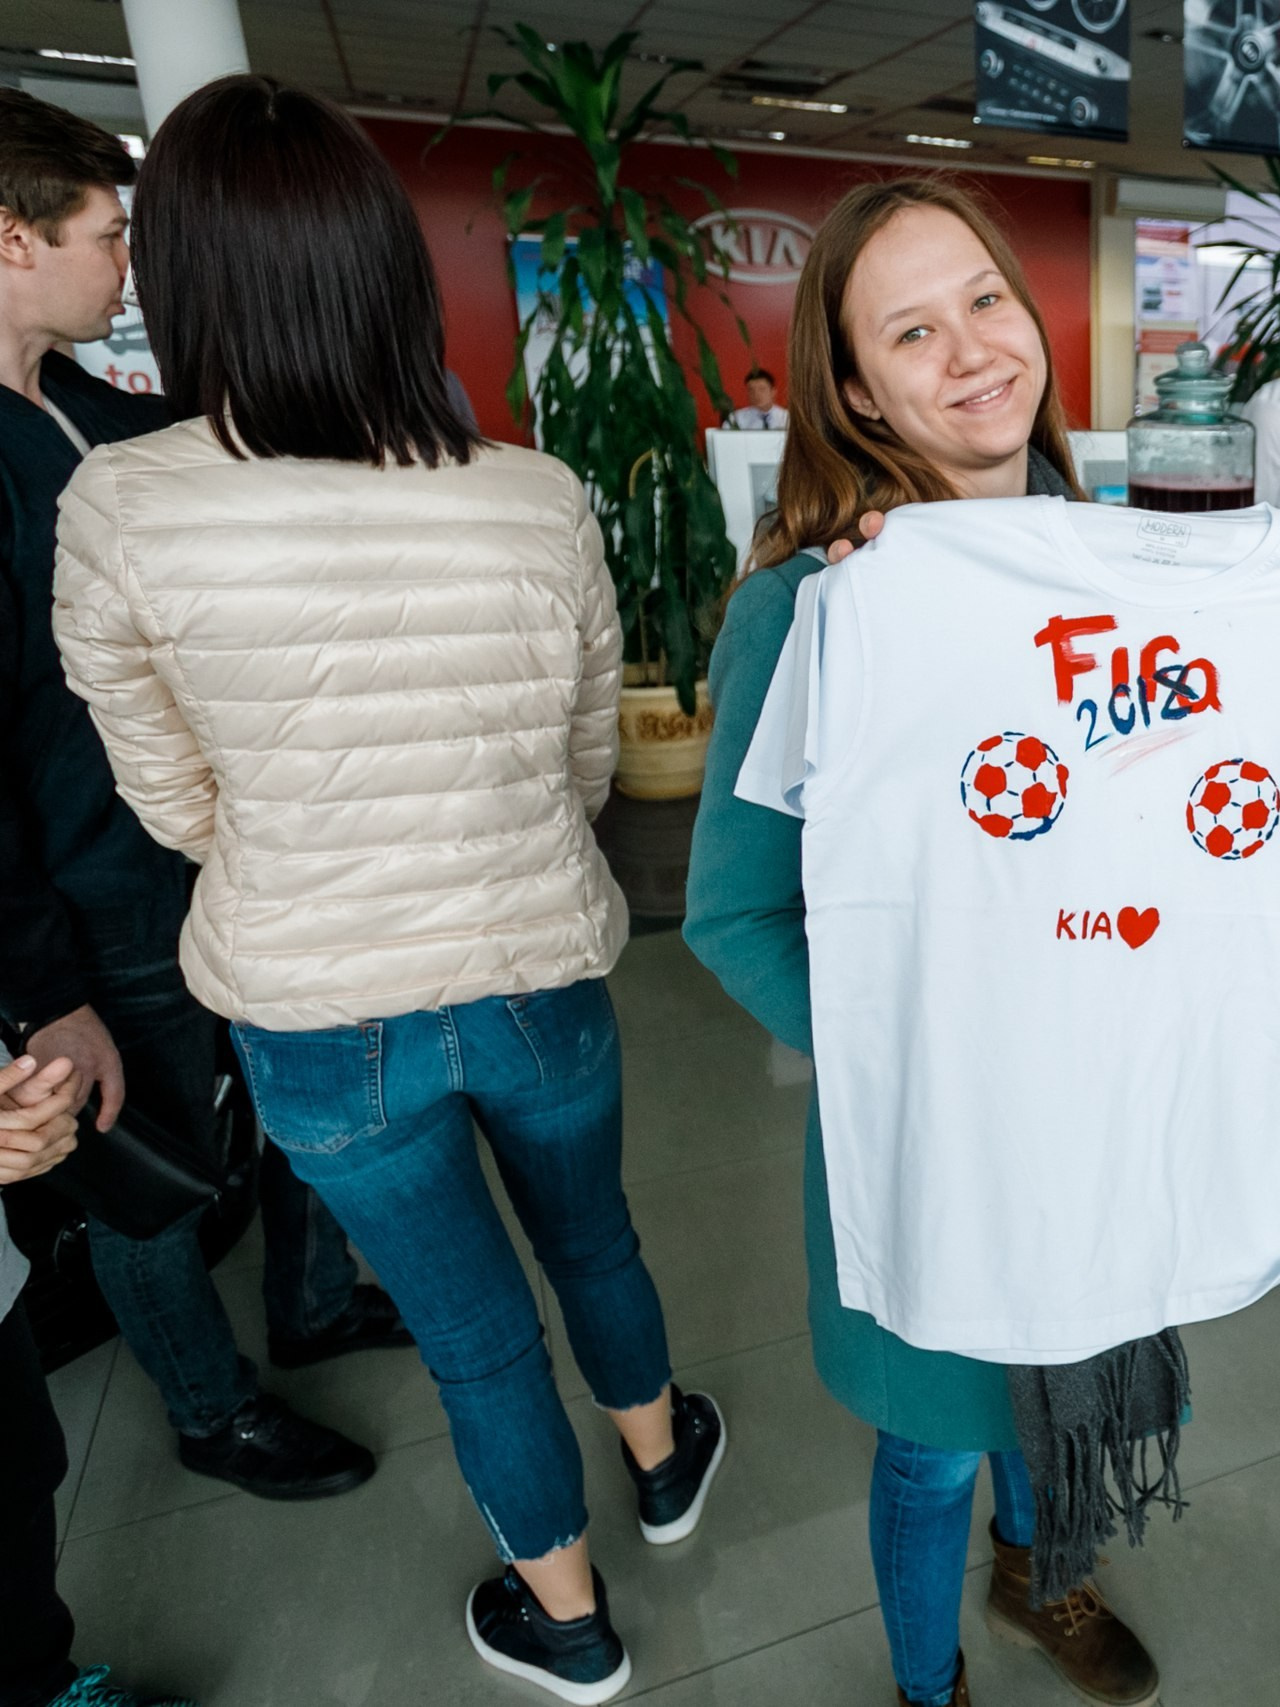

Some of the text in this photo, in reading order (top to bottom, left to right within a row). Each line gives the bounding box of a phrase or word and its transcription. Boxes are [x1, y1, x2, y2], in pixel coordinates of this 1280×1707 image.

[711, 223, 805, 268] KIA
[1076, 664, 1200, 752] 2018
[1056, 908, 1112, 940] KIA
